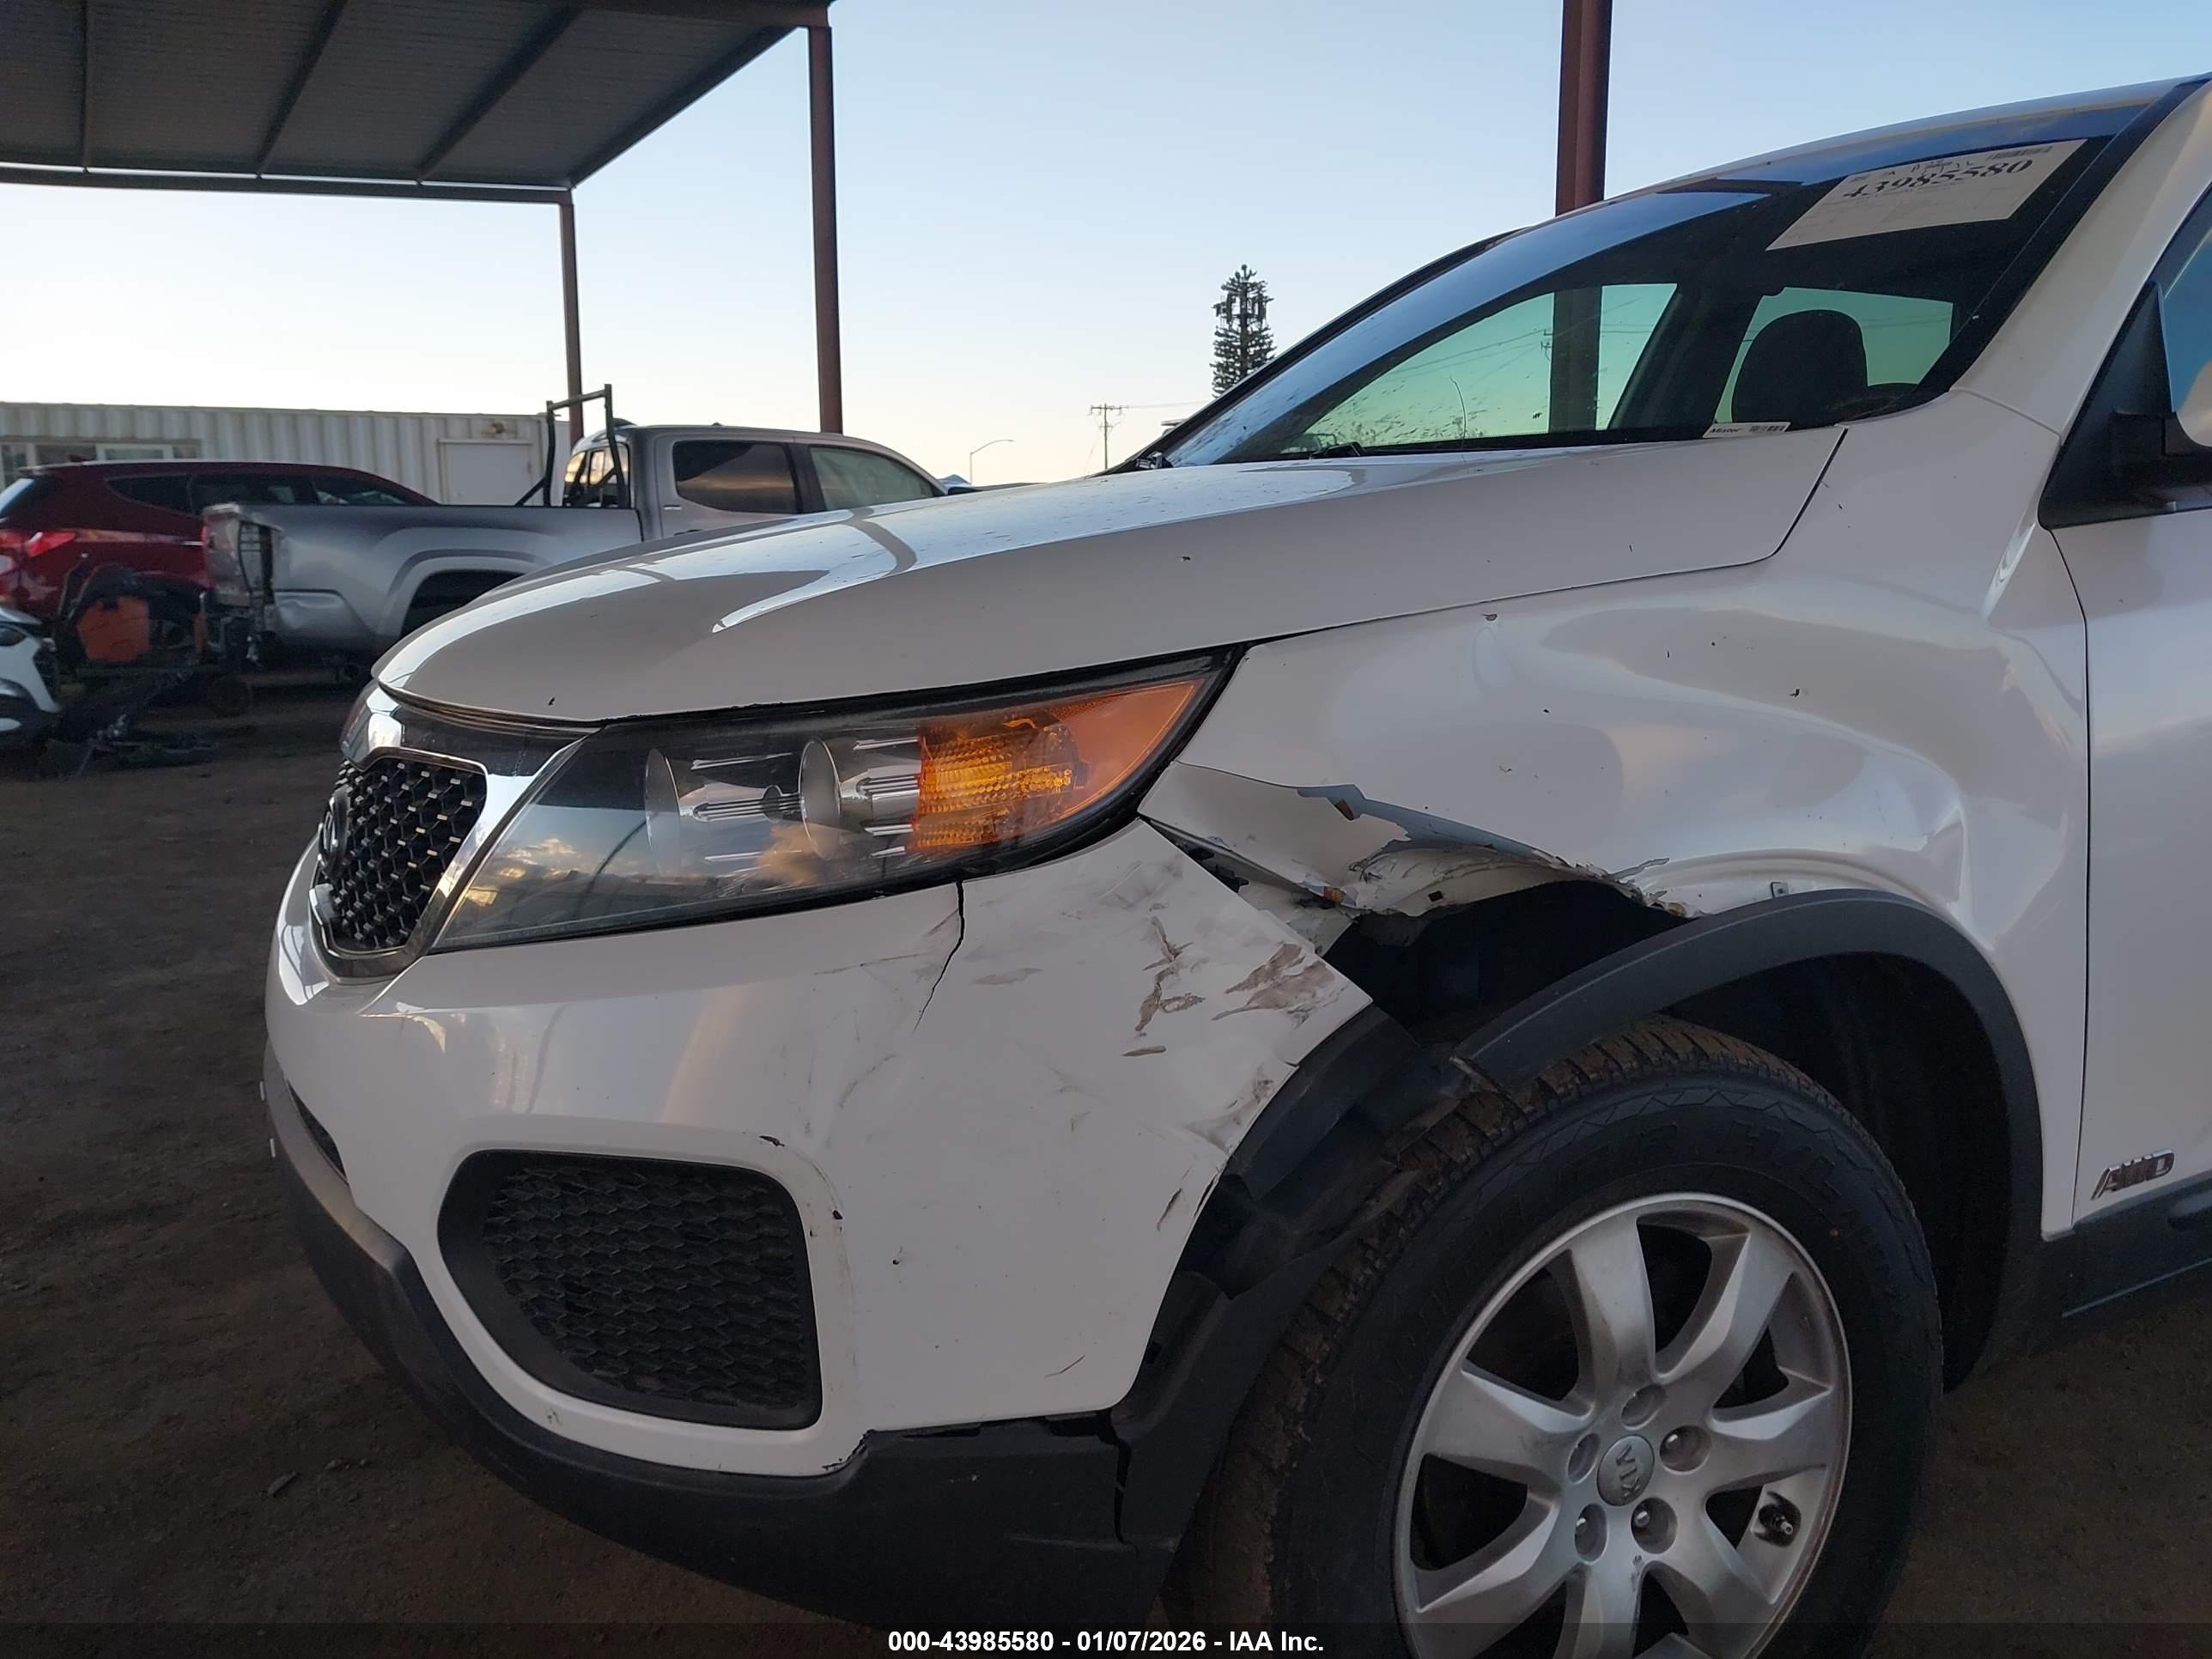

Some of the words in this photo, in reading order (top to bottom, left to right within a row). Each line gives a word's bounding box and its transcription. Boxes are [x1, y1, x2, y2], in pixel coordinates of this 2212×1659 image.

[1842, 159, 2033, 198] 43985580
[2090, 1148, 2175, 1200] AWD
[1616, 1443, 1641, 1500] KIA
